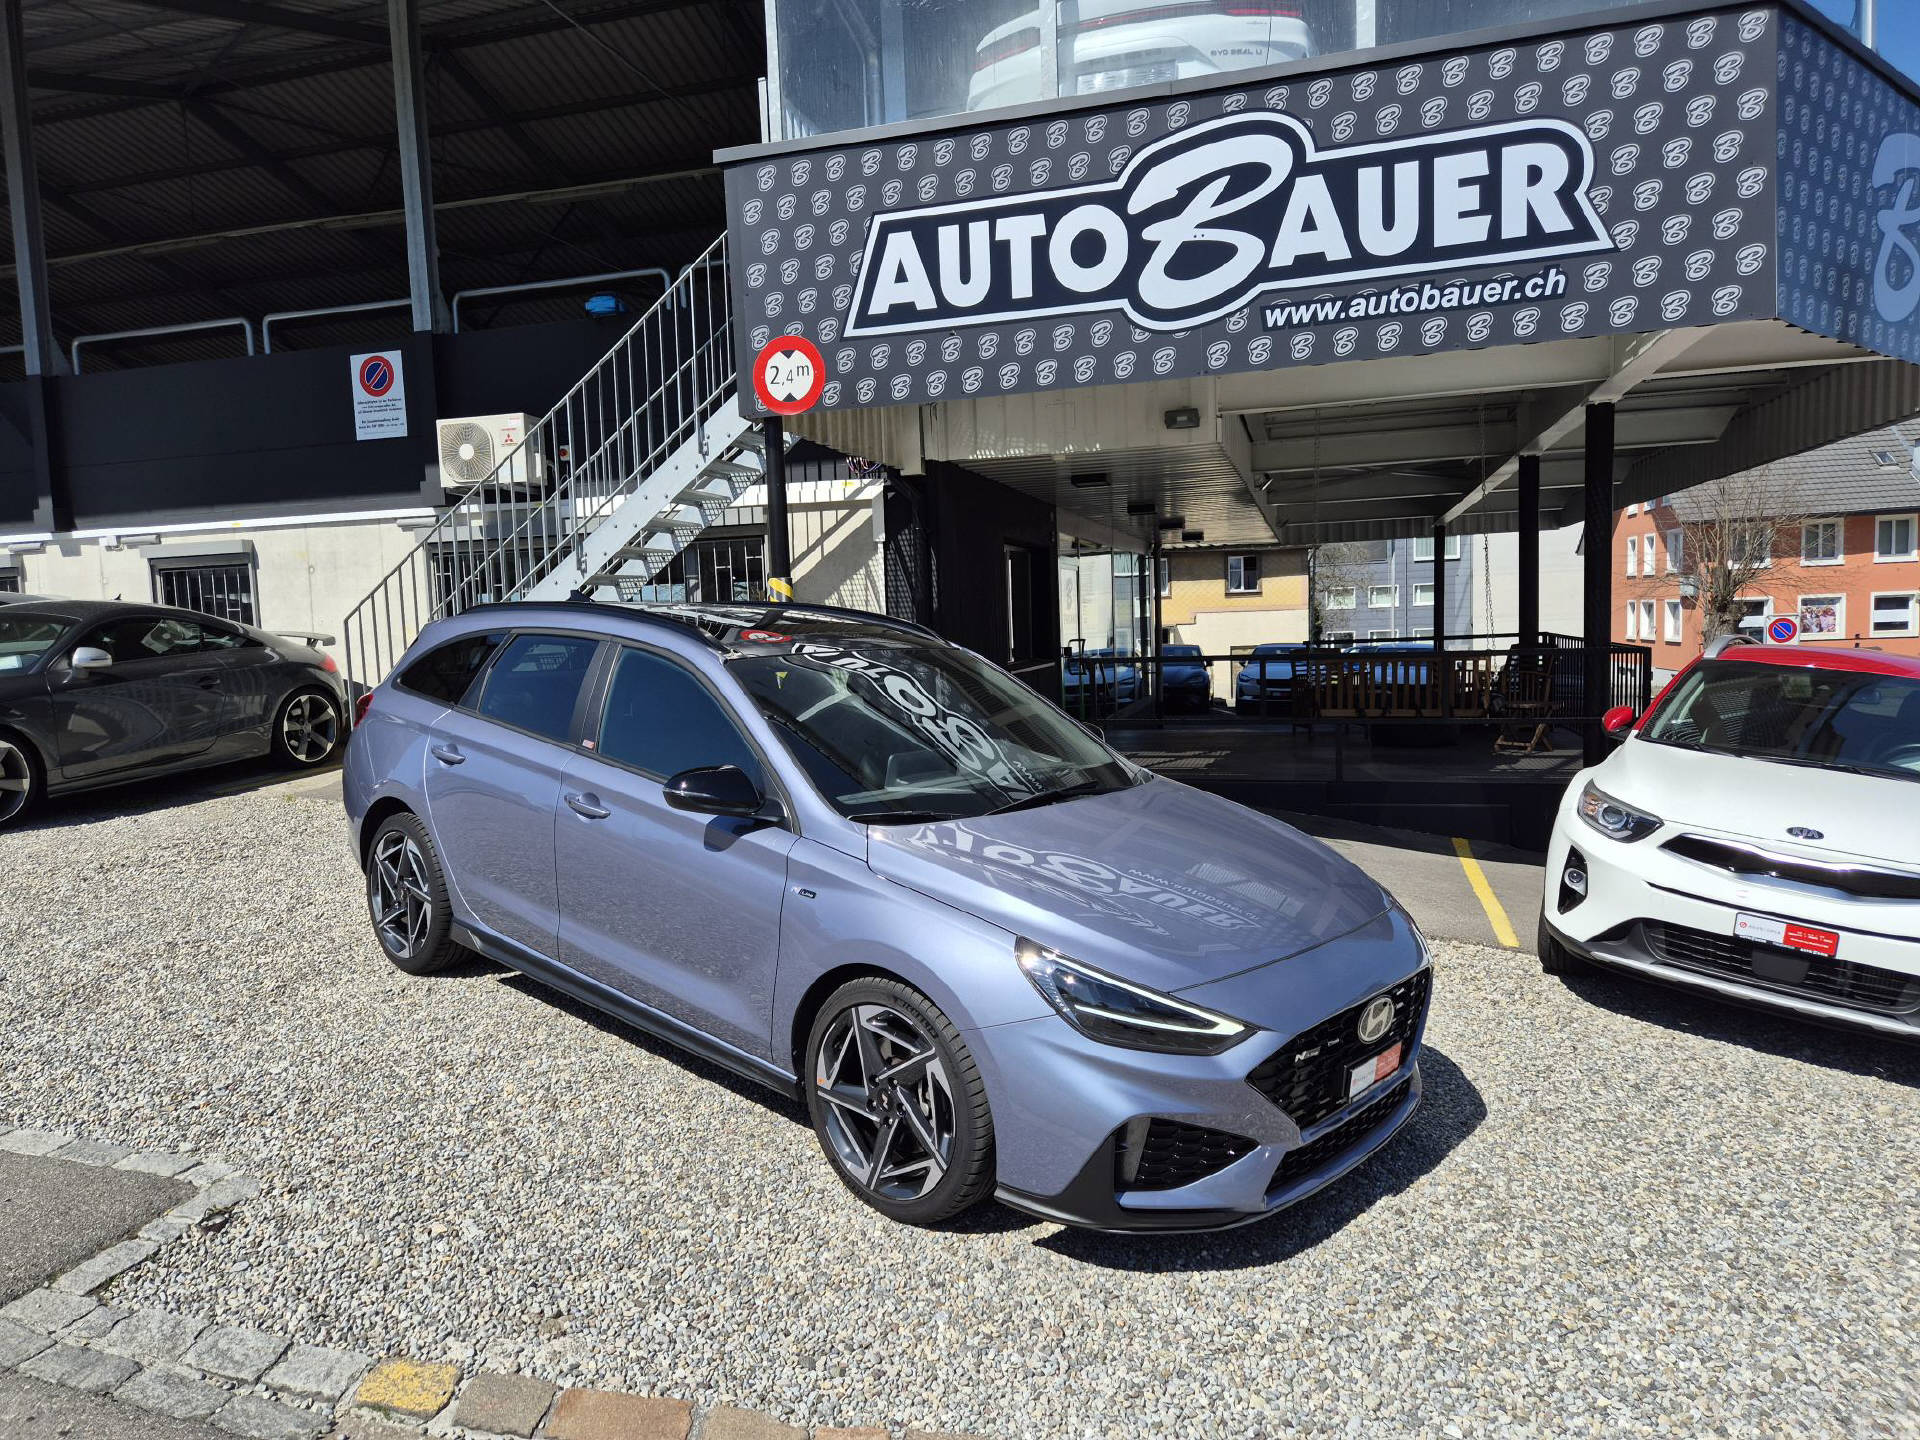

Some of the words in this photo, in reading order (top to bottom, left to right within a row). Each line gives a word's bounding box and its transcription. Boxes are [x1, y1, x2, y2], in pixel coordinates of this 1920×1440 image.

[868, 204, 1129, 315] AUTO
[1127, 134, 1574, 310] BAUER
[1265, 268, 1566, 327] www.autobauer.ch
[1791, 827, 1820, 839] KIA
